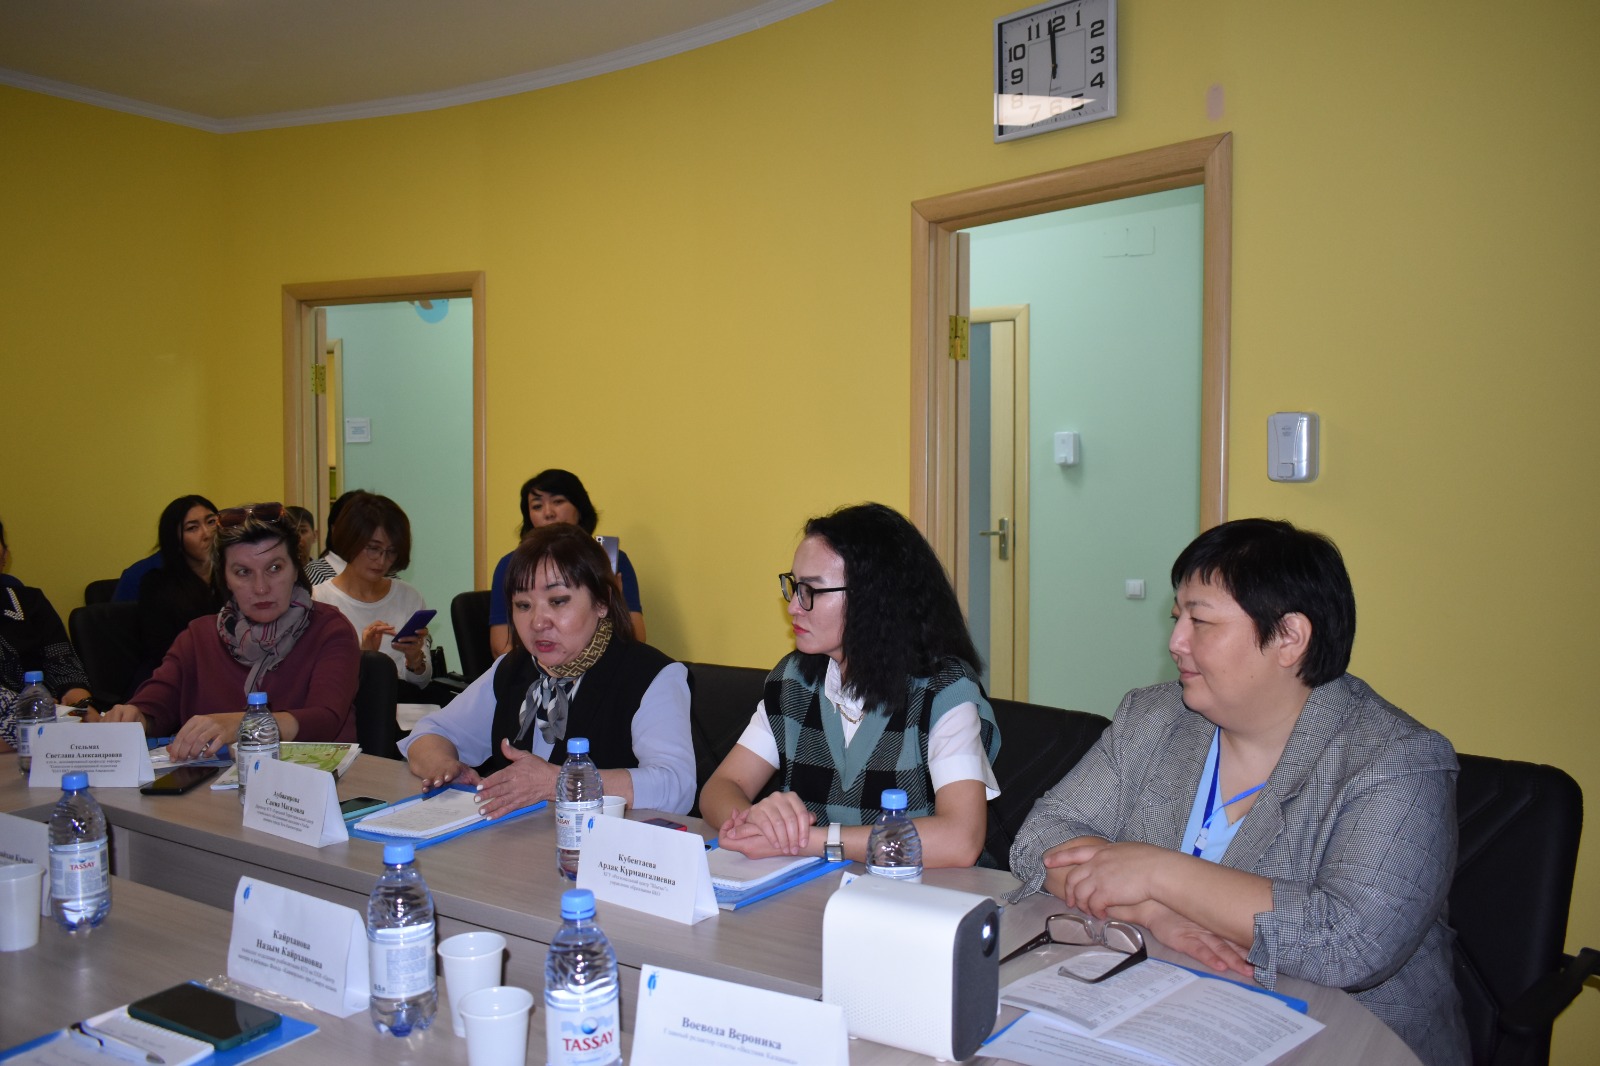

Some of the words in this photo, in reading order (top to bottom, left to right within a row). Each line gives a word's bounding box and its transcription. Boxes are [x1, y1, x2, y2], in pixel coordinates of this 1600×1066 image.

[1047, 15, 1066, 36] 12
[1076, 10, 1081, 27] 1
[1028, 22, 1040, 41] 11
[1090, 19, 1105, 39] 2
[1008, 43, 1026, 62] 10
[1090, 45, 1105, 64] 3
[1011, 67, 1023, 85] 9
[1090, 72, 1105, 88] 4
[1071, 93, 1084, 111] 5
[70, 861, 95, 871] TASSAY
[598, 861, 618, 872] Ардак
[618, 854, 657, 869] Кубентаева
[273, 929, 311, 950] Кайрханова
[256, 938, 280, 954] Назым
[281, 946, 322, 969] Кайрхановна
[562, 1028, 613, 1052] TASSAY
[682, 1016, 726, 1036] Воевода
[728, 1028, 782, 1050] Вероника
